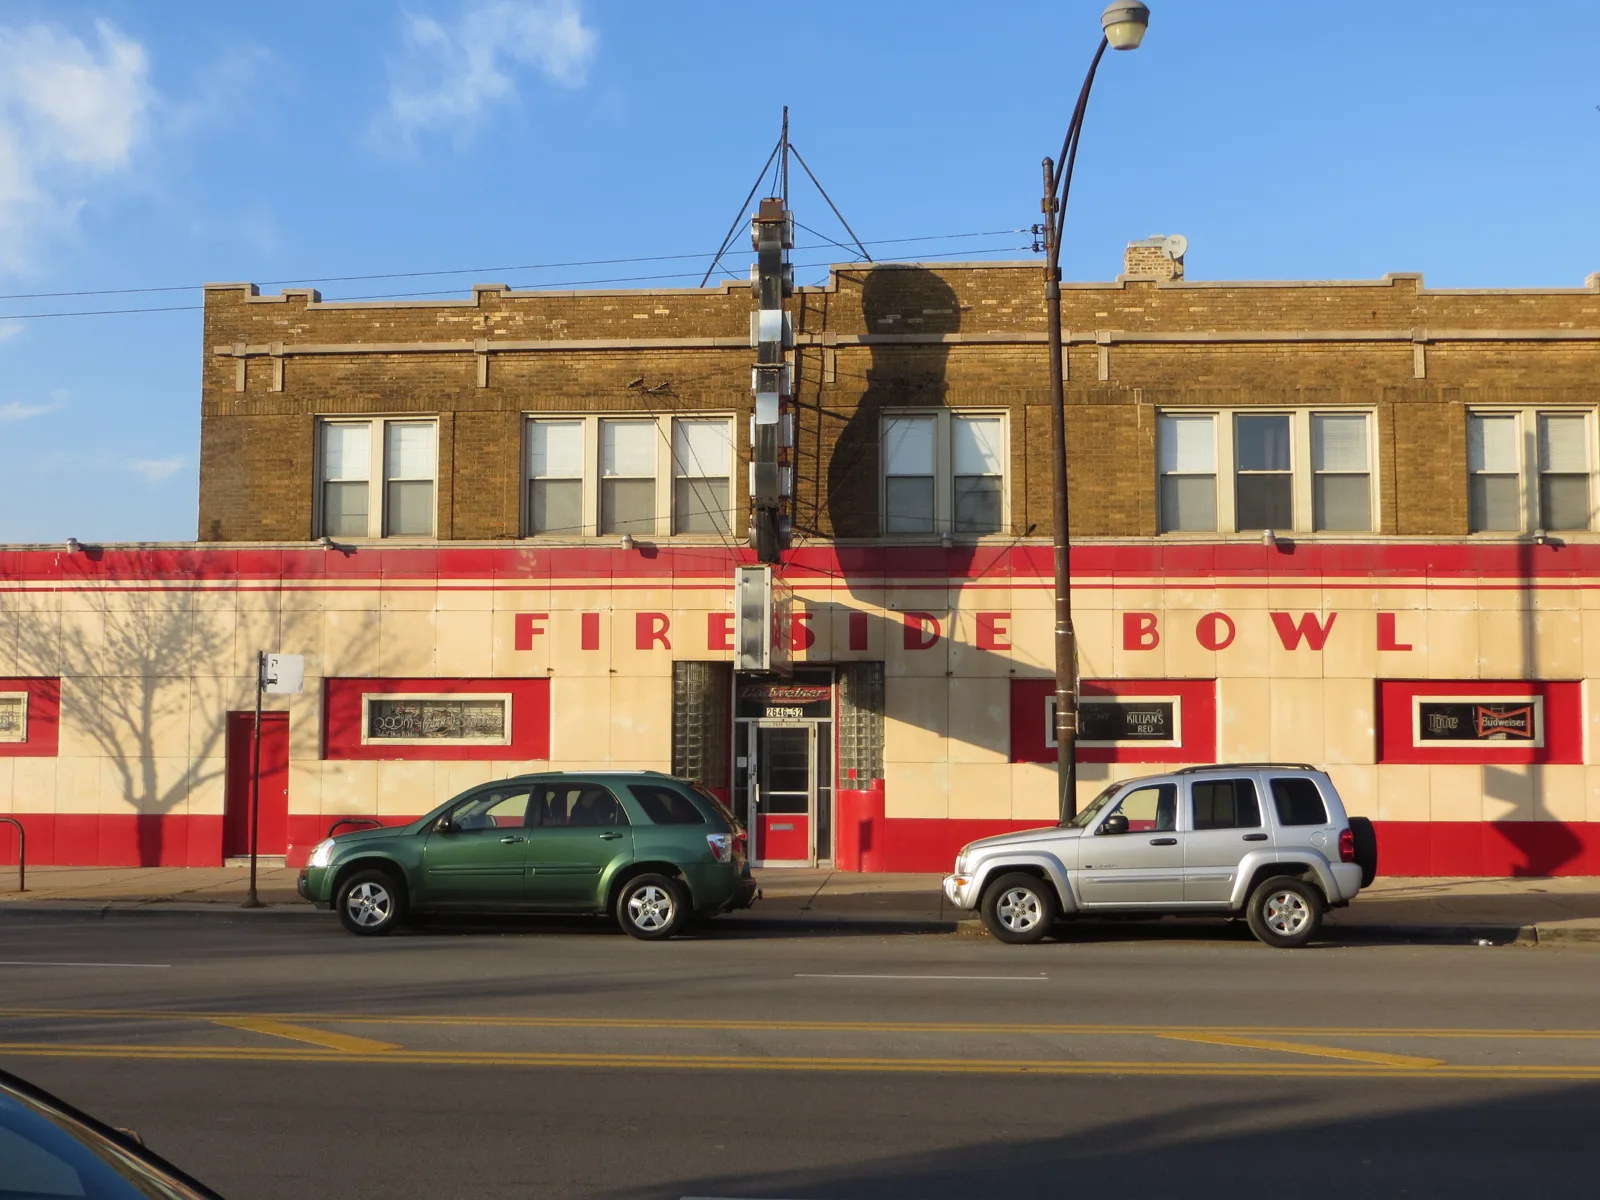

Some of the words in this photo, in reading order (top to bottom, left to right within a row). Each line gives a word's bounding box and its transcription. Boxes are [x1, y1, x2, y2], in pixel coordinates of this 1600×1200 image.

[514, 612, 1011, 651] FIRESIDE
[1124, 611, 1412, 652] BOWL
[767, 707, 802, 717] 2646-52
[1126, 714, 1164, 725] KILLIAN'S
[1481, 716, 1526, 727] Budweiser
[1137, 725, 1154, 733] RED
